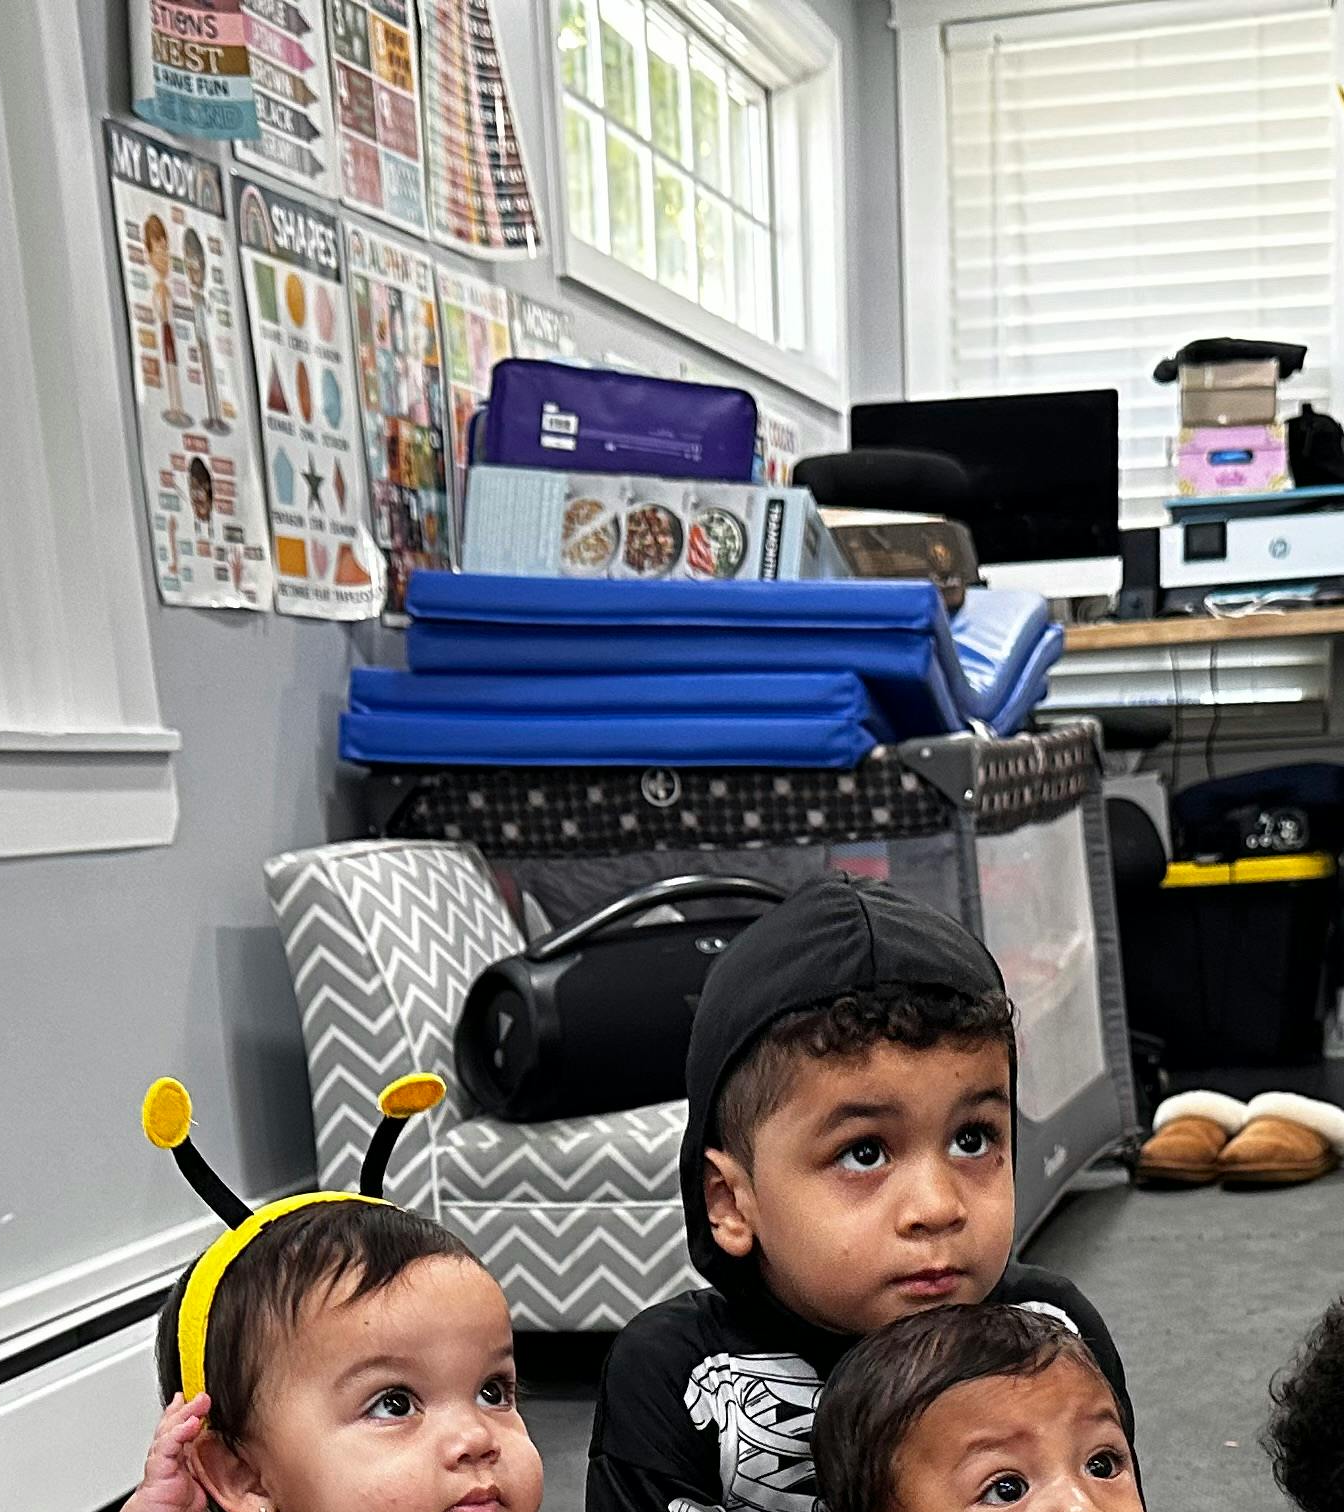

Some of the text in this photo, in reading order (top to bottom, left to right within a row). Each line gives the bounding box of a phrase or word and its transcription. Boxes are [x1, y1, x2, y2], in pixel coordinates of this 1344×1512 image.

[112, 129, 196, 202] MY BODY
[271, 204, 338, 271] SHAPES
